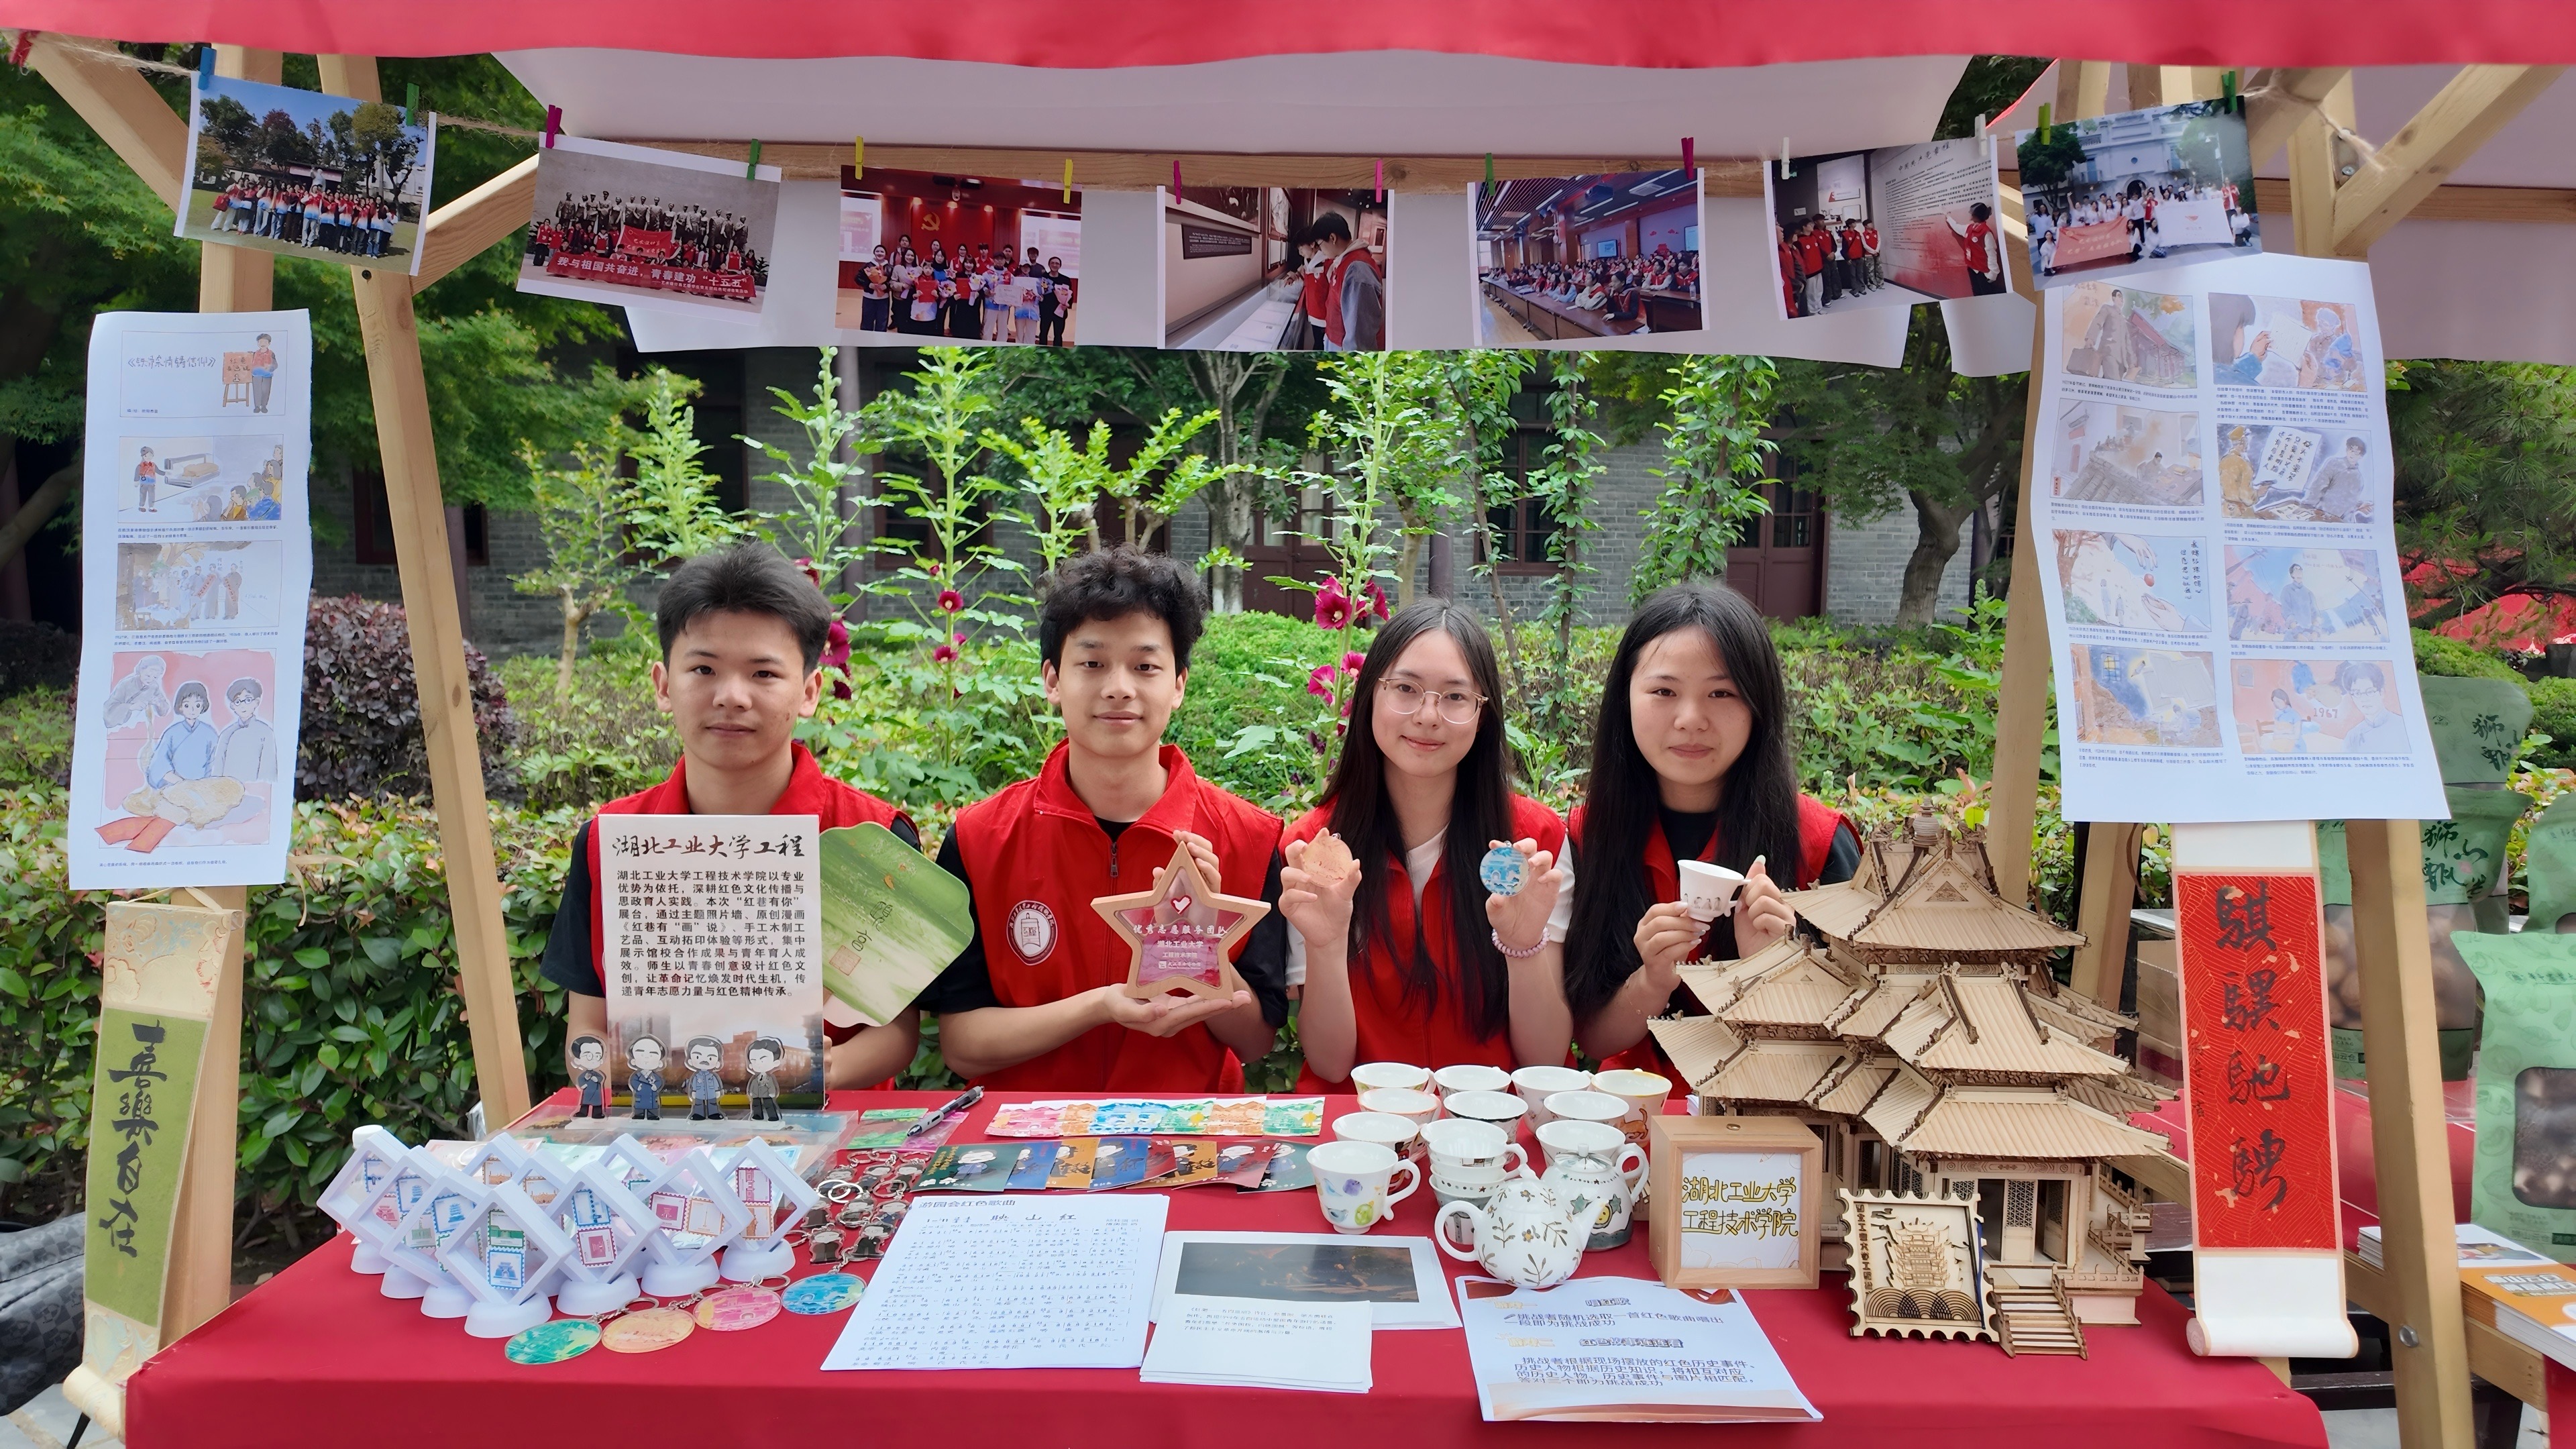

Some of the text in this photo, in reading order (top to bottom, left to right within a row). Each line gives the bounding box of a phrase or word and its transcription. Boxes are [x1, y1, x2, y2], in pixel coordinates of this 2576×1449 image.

[2313, 707, 2338, 718] 1967
[611, 833, 805, 859] 湖北工业大学工程
[616, 870, 804, 881] 湖北工业大学工程技术学院以专业
[617, 883, 804, 894] 优势为依托，深耕红色文化传播与
[619, 909, 805, 920] 展台，通过主题照片墙、原创漫画
[1133, 924, 1228, 935] 优秀志愿服务团队
[621, 934, 806, 945] 艺品、互动拓印体验等形式，集中
[1157, 940, 1204, 949] 湖北工业大学
[620, 947, 806, 958] 展示馆校合作成果与青年育人成
[621, 960, 806, 971] 效。师生以青春创意设计红色文
[621, 973, 806, 984] 创，让革命记忆焕发时代生机，传
[621, 986, 792, 997] 递青年志愿力量与红色精神传承。
[1681, 1175, 1797, 1207] 湖北工业大学
[918, 1199, 1016, 1208] 游园会红色歌曲
[1681, 1207, 1799, 1240] 工程技术学院
